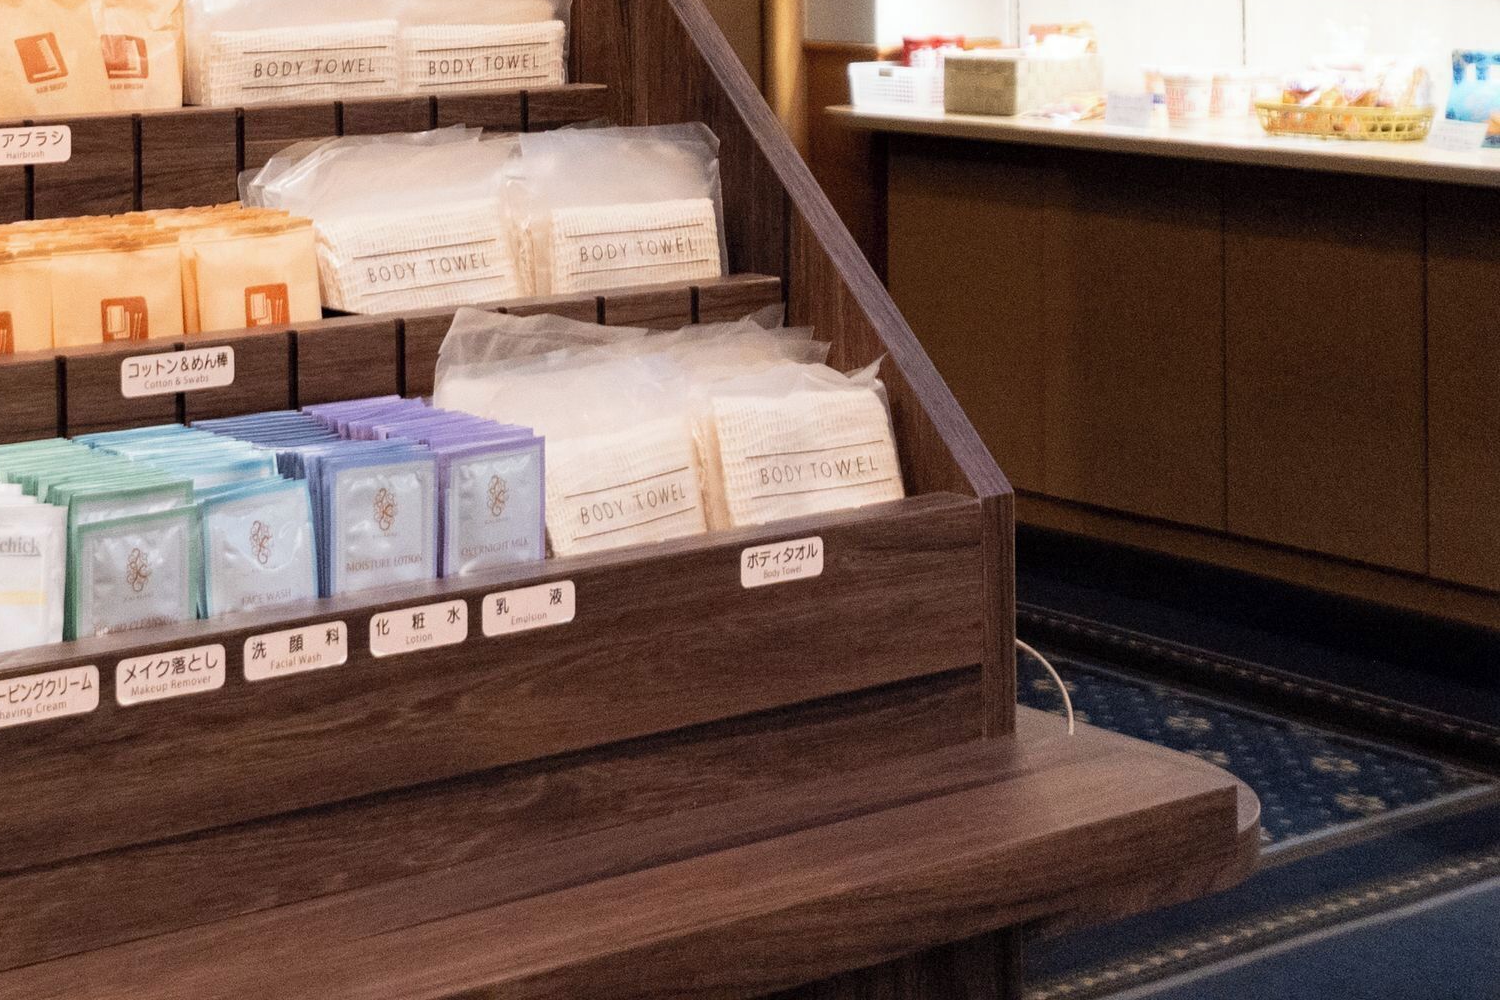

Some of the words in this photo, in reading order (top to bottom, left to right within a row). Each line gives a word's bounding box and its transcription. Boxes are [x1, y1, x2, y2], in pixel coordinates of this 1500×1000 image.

[253, 60, 304, 79] BODY
[313, 57, 376, 76] TOWEL
[428, 58, 475, 77] BODY
[481, 53, 540, 72] TOWEL
[6, 151, 45, 159] Hairbrush
[580, 243, 626, 263] BODY
[637, 236, 698, 257] TOWEL
[368, 261, 418, 284] BODY
[428, 253, 491, 276] TOWEL
[128, 352, 228, 378] コットン&めん棒
[144, 379, 173, 390] Cotton
[183, 375, 209, 383] Swabs
[760, 462, 802, 485] BODY
[809, 454, 879, 479] TOWEL
[581, 500, 624, 526] BODY
[635, 483, 687, 509] TOWEL
[461, 542, 509, 558] OVERNIGHT
[747, 543, 818, 569] ボディタオル
[346, 557, 390, 574] MOISTURE
[394, 552, 423, 567] LOTION
[376, 606, 461, 637] 化粧水
[510, 611, 548, 626] Emulsion
[251, 627, 340, 660] 洗顔料
[405, 632, 433, 645] Lotion
[123, 651, 218, 684] メイク落とし
[270, 657, 298, 671] Facial
[299, 653, 322, 666] Wash
[131, 682, 168, 697] Makeup
[171, 675, 211, 690] Remover
[35, 701, 67, 714] Cream
